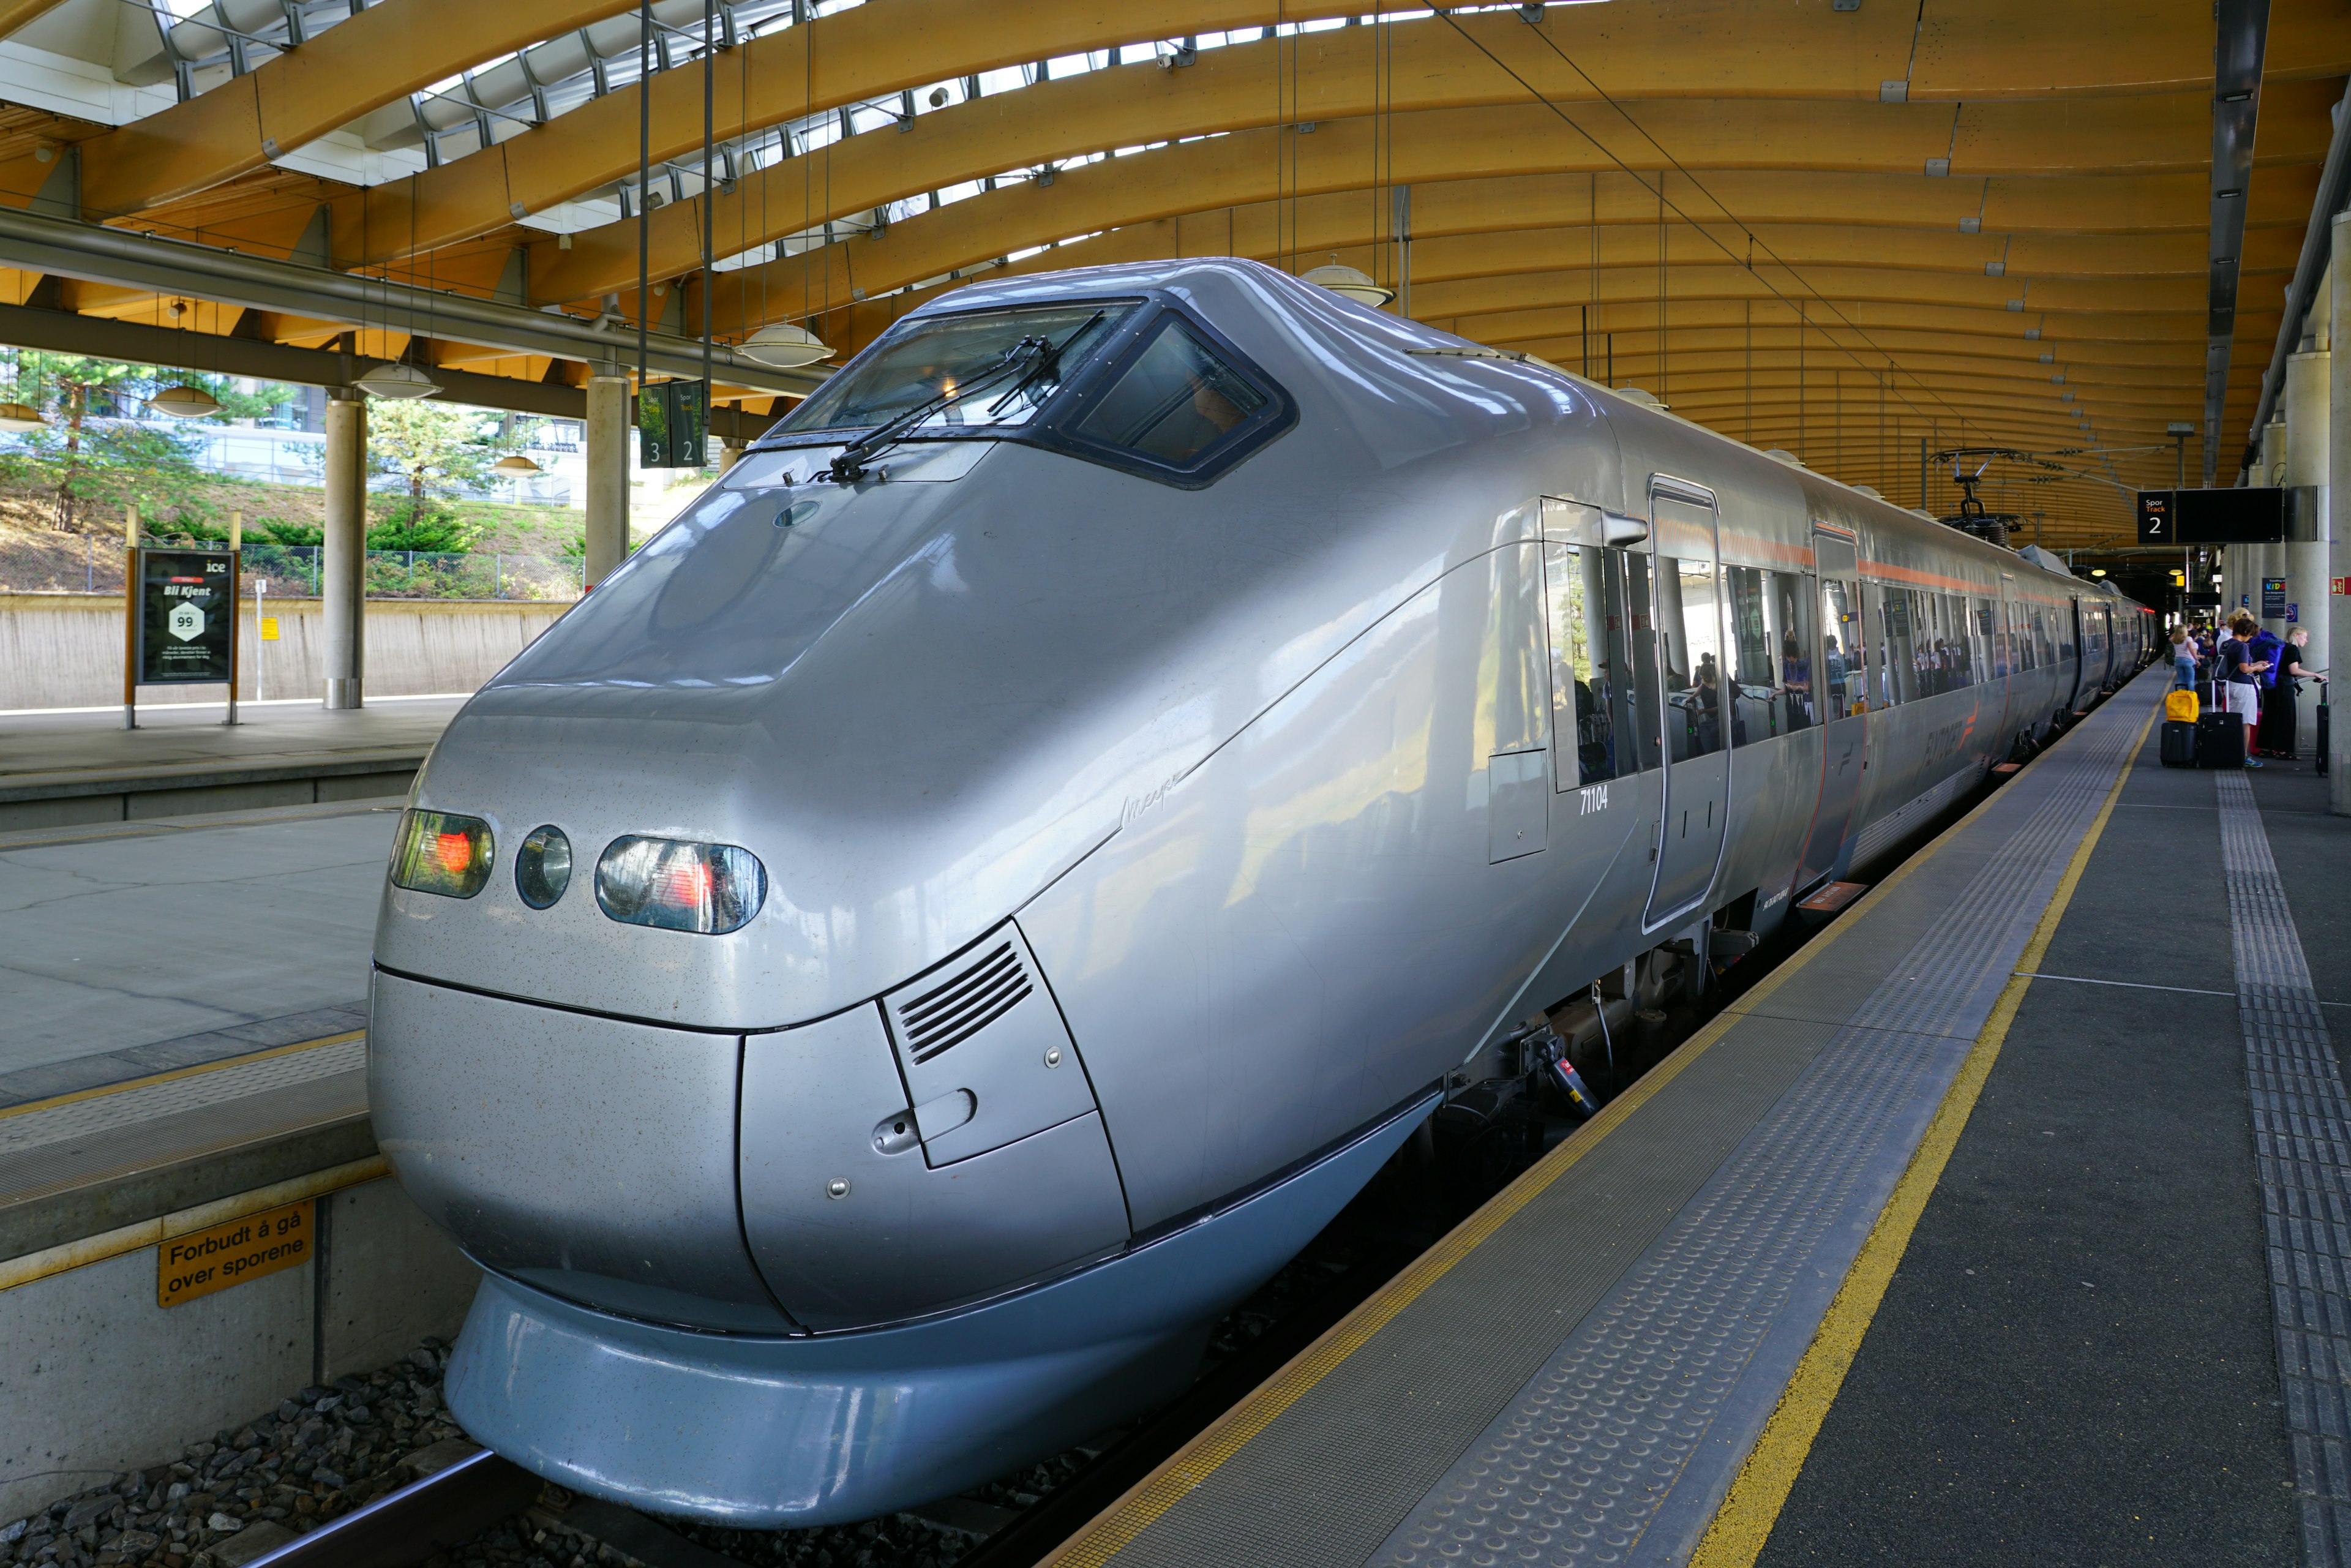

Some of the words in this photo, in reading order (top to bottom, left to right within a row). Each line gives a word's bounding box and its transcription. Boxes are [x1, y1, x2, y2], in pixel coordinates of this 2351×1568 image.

[651, 442, 660, 462] 3
[683, 441, 692, 460] 2
[2149, 517, 2161, 534] 2
[206, 559, 226, 572] ice
[163, 585, 179, 596] Bli
[181, 585, 211, 598] Kjent
[1581, 784, 1608, 816] 71104
[171, 1226, 250, 1265] Forbudt
[258, 1220, 269, 1238] å
[277, 1210, 301, 1236] gå
[168, 1267, 216, 1292] over
[223, 1239, 304, 1275] sporene
